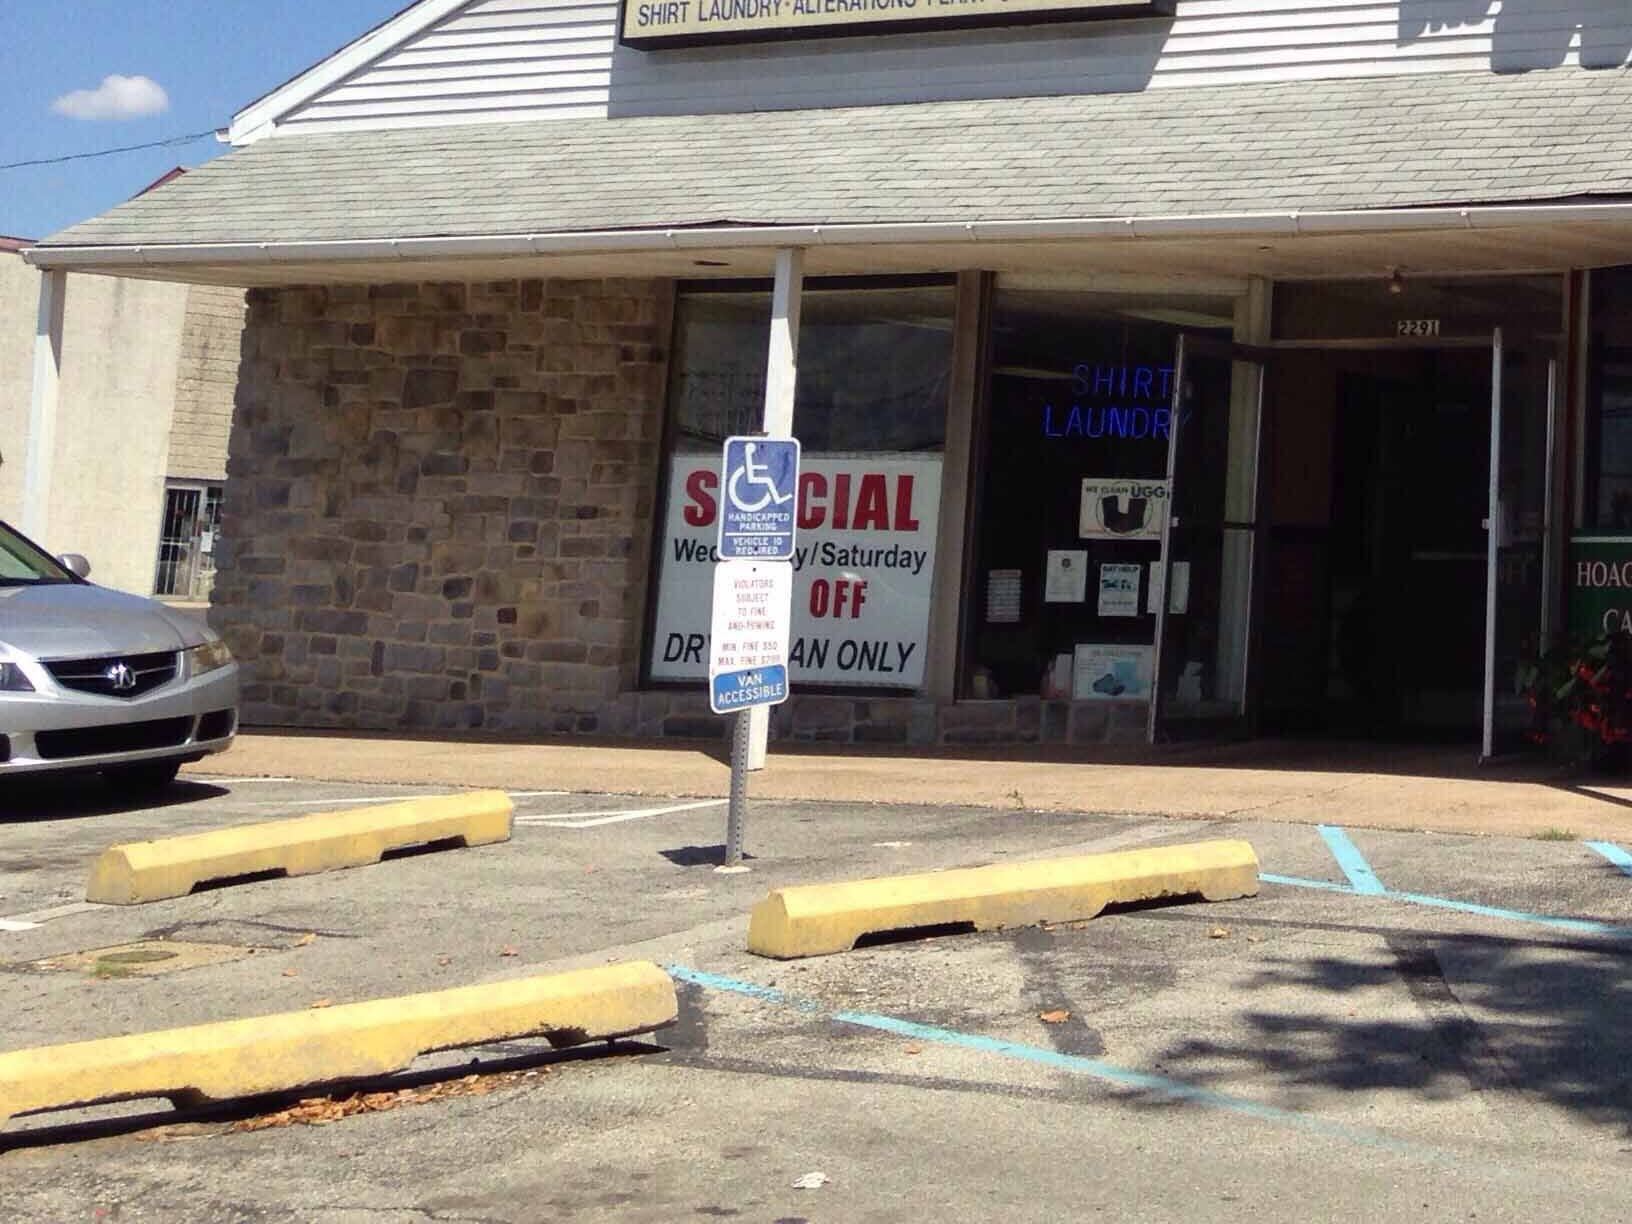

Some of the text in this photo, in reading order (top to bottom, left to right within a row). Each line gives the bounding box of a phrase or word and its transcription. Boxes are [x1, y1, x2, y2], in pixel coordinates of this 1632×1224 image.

[637, 1, 690, 26] SHIRT
[1399, 320, 1438, 336] 2291
[1072, 363, 1176, 399] SHIRT
[683, 470, 920, 531] SCIAL
[727, 512, 790, 522] HANDICAPPED
[739, 522, 777, 532] PARKING
[733, 536, 769, 546] VEHICLE
[809, 578, 868, 619] OFF
[663, 632, 711, 664] DR
[837, 639, 916, 673] ONLY
[737, 672, 763, 687] VAN
[718, 683, 783, 705] ACCESSIBLE
